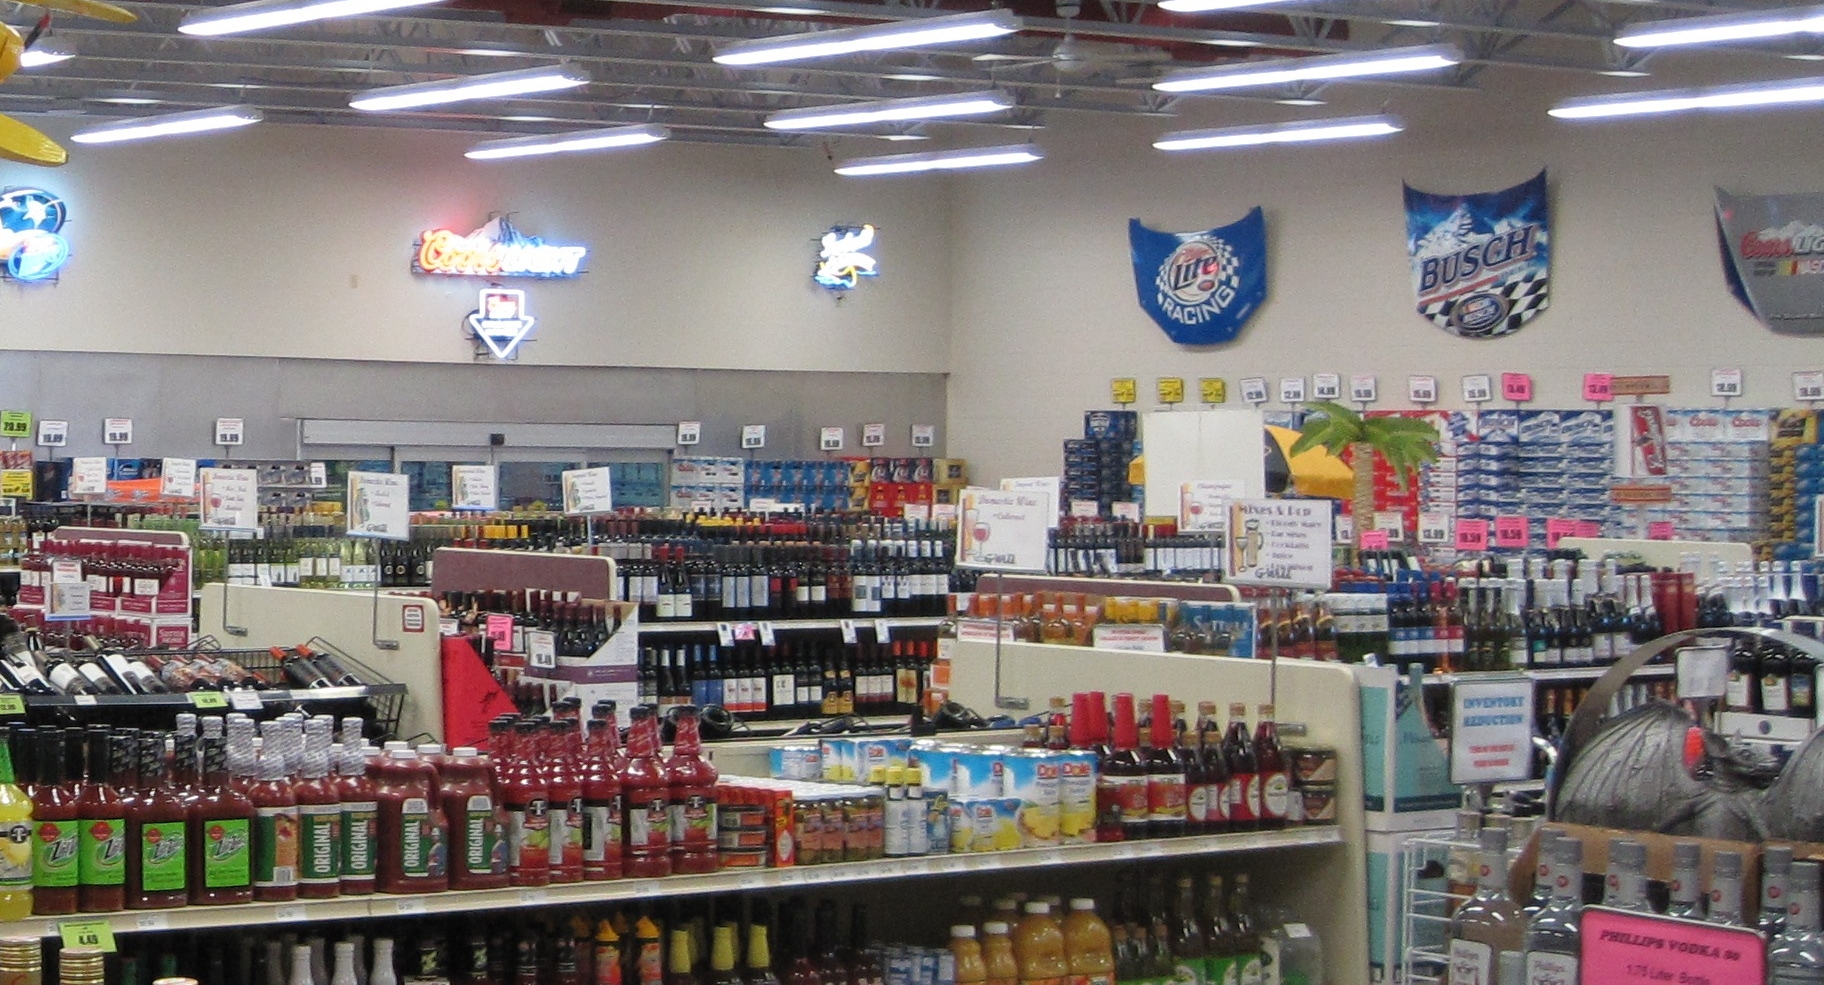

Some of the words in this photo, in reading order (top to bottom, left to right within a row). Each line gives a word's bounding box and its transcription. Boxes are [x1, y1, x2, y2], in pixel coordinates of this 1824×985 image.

[1173, 255, 1220, 292] Lite
[1419, 224, 1534, 294] BUSCH
[1161, 285, 1236, 325] RACING
[1463, 696, 1525, 709] INVENTORY
[314, 822, 331, 873] ORIGINAL
[351, 819, 368, 870] ORIGINAL
[403, 820, 420, 868] ORIGINAL
[469, 818, 484, 864] ORIGINAL
[1599, 929, 1665, 950] PHILLIPS
[1668, 940, 1721, 959] VODKA
